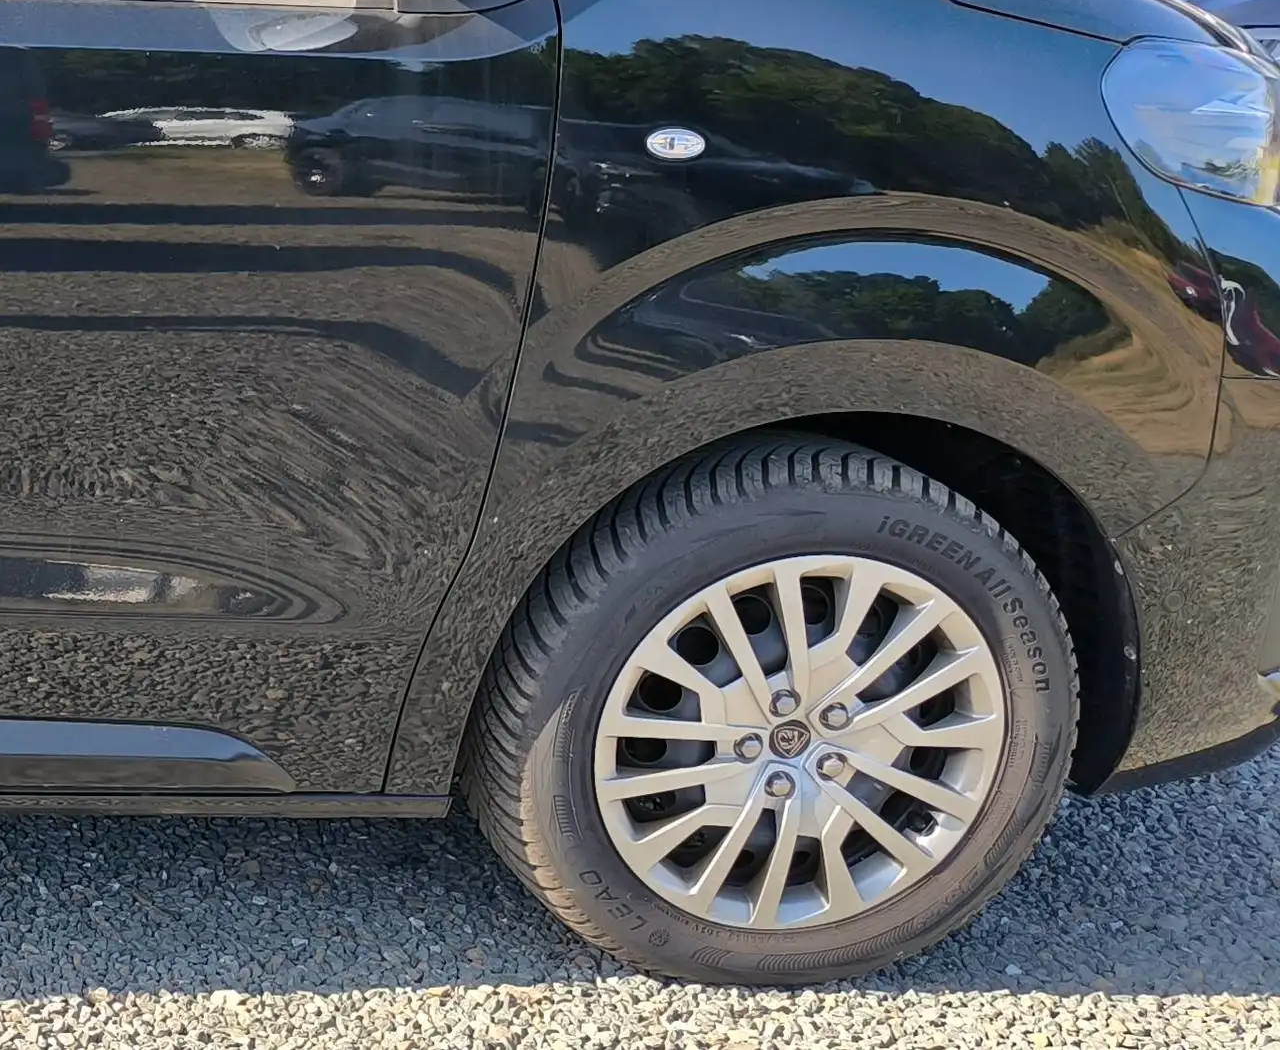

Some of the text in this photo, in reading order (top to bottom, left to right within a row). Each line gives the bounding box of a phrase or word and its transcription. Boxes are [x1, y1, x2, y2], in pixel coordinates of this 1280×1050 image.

[876, 515, 982, 571] iGREEN
[1002, 596, 1051, 694] Season
[578, 868, 650, 932] LEAO
